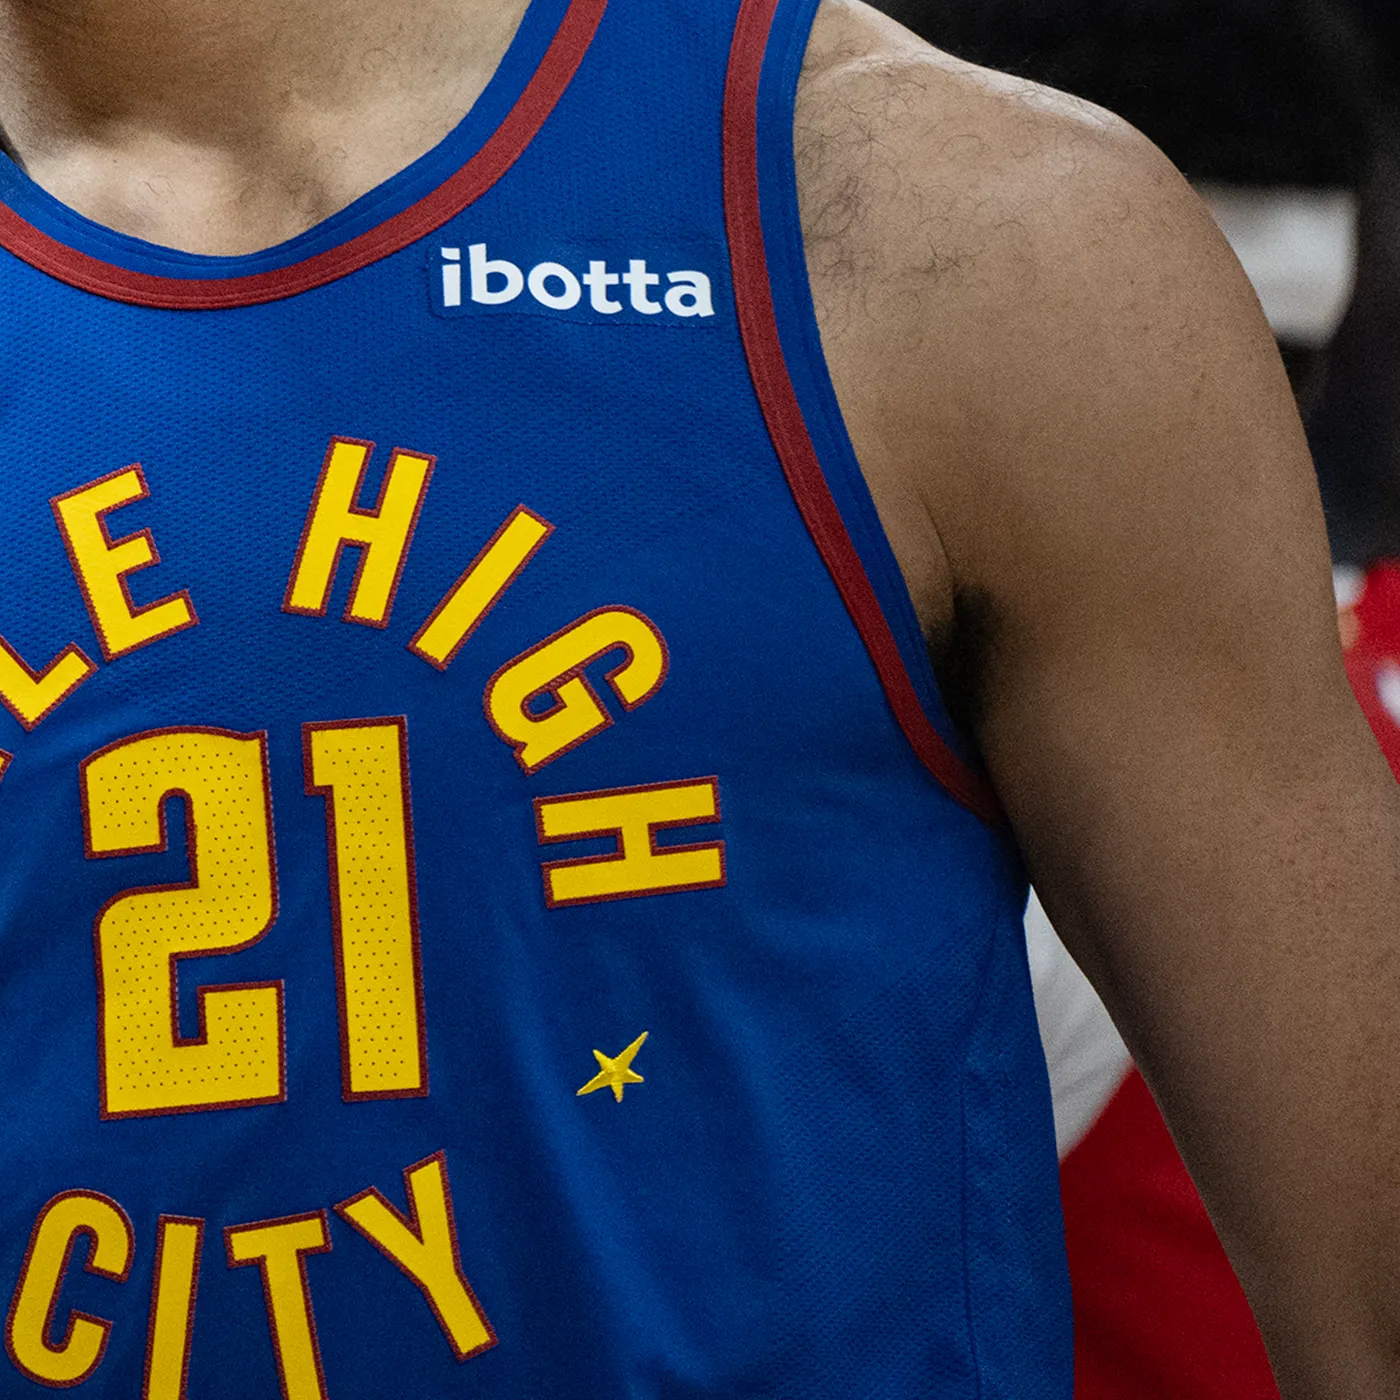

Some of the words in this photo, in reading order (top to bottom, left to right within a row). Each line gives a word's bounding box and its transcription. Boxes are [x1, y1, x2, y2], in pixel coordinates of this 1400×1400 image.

[441, 242, 717, 319] ibotta
[283, 436, 727, 907] HIGH
[79, 717, 427, 1120] 21
[6, 1150, 497, 1400] CITY
